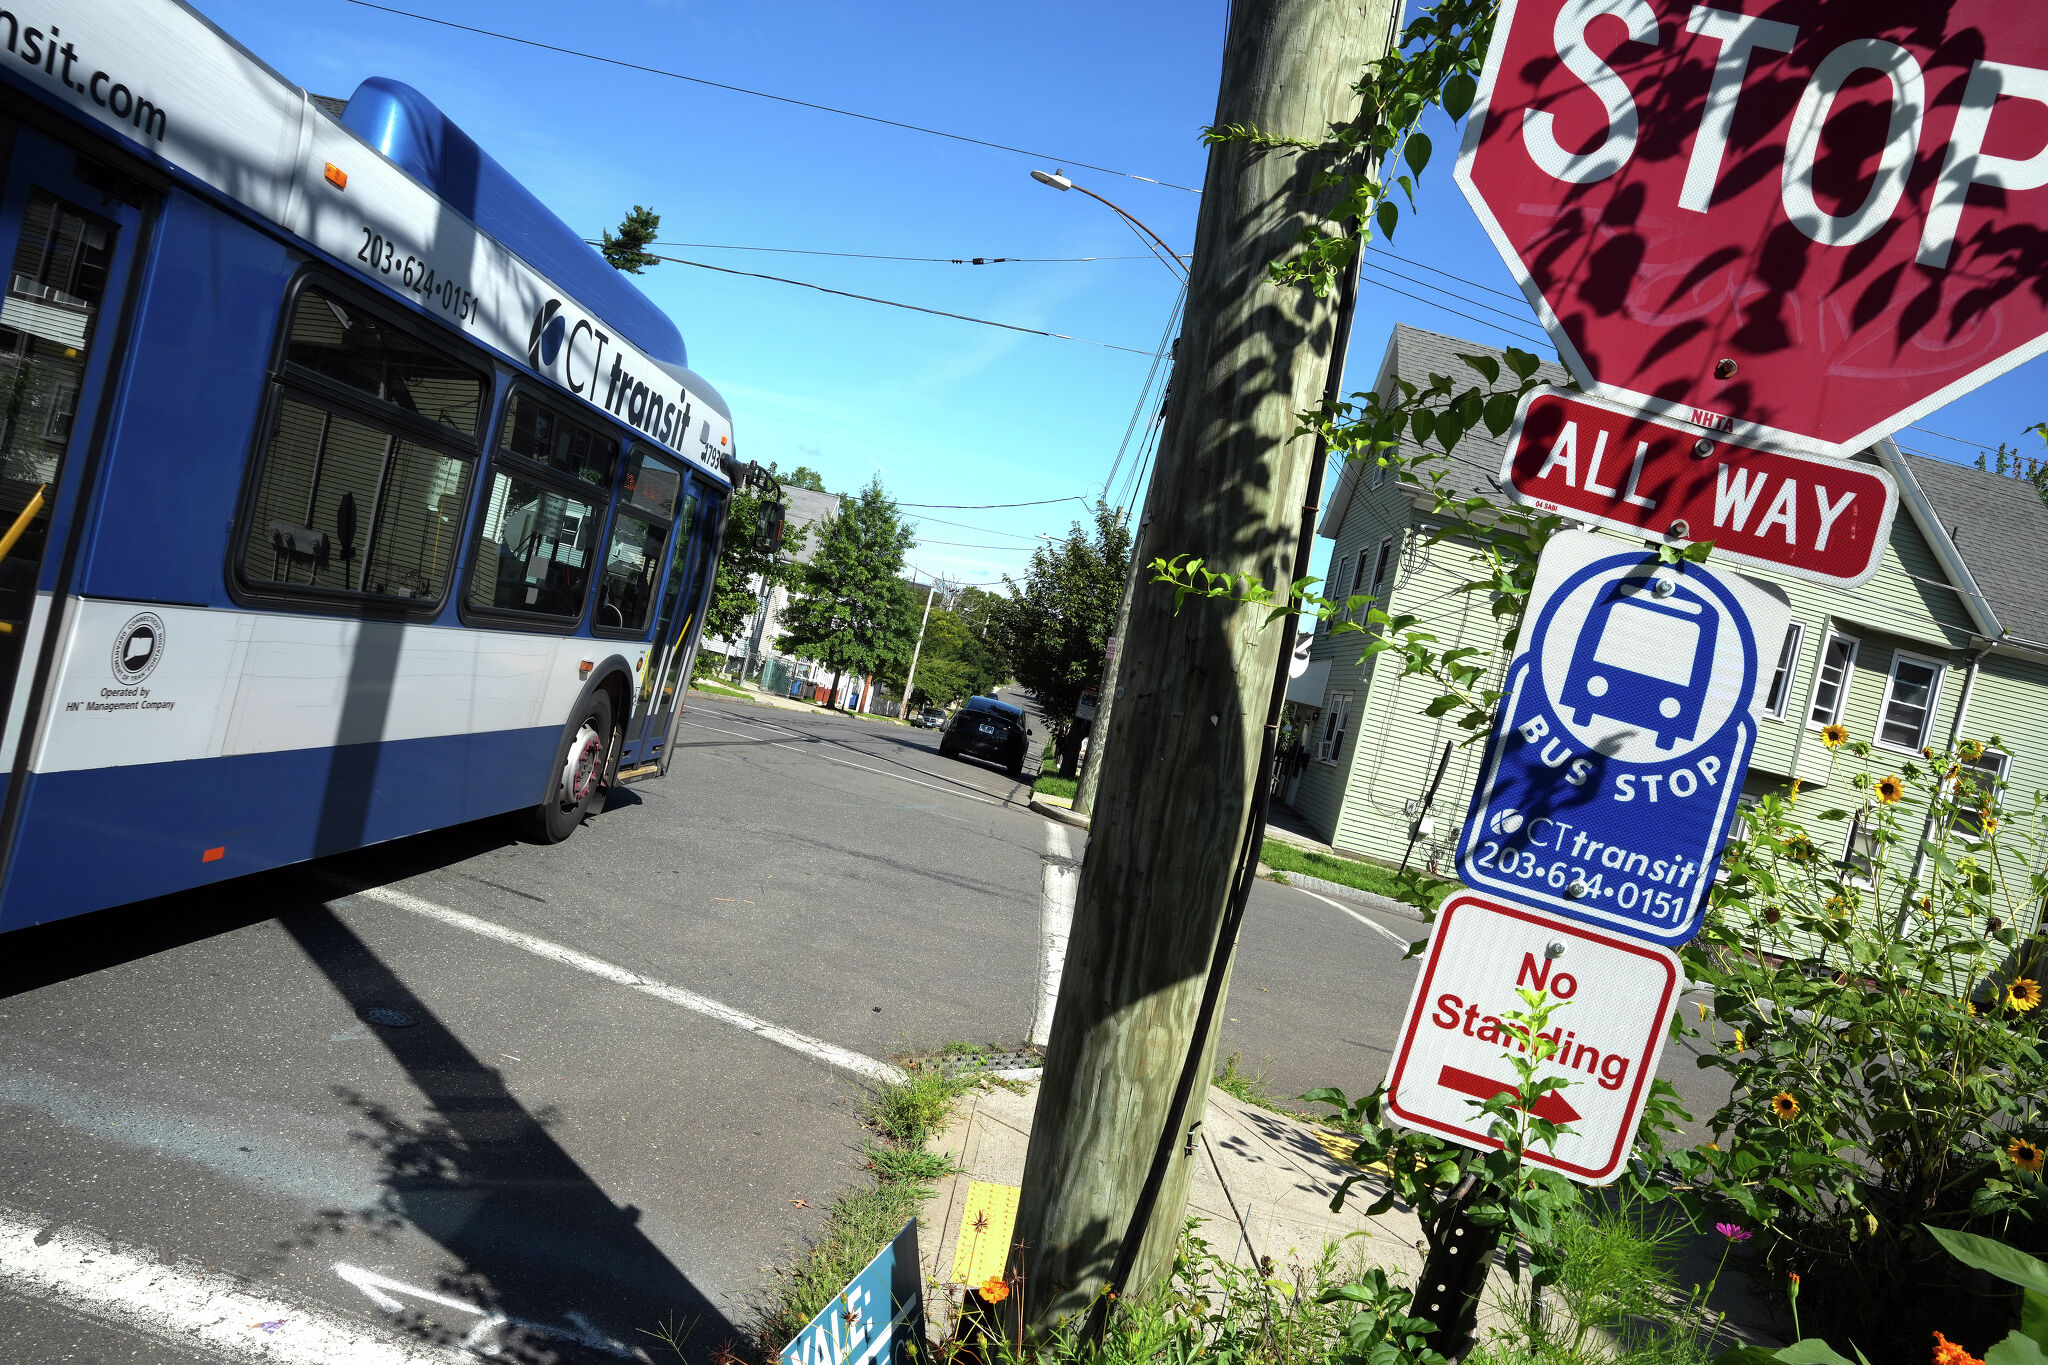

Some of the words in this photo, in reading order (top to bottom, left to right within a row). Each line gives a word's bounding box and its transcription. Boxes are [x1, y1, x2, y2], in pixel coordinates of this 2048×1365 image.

[1522, 0, 2048, 269] STOP
[1690, 408, 1735, 433] NHTA
[1536, 420, 1657, 510] ALL
[1713, 462, 1858, 552] WAY
[86, 701, 139, 713] Management
[141, 700, 176, 711] Company
[100, 687, 139, 699] Operated
[140, 687, 150, 698] by
[1518, 714, 1593, 786] BUS
[1614, 755, 1721, 803] STOP
[1516, 952, 1578, 999] No
[1432, 993, 1630, 1091] Standing
